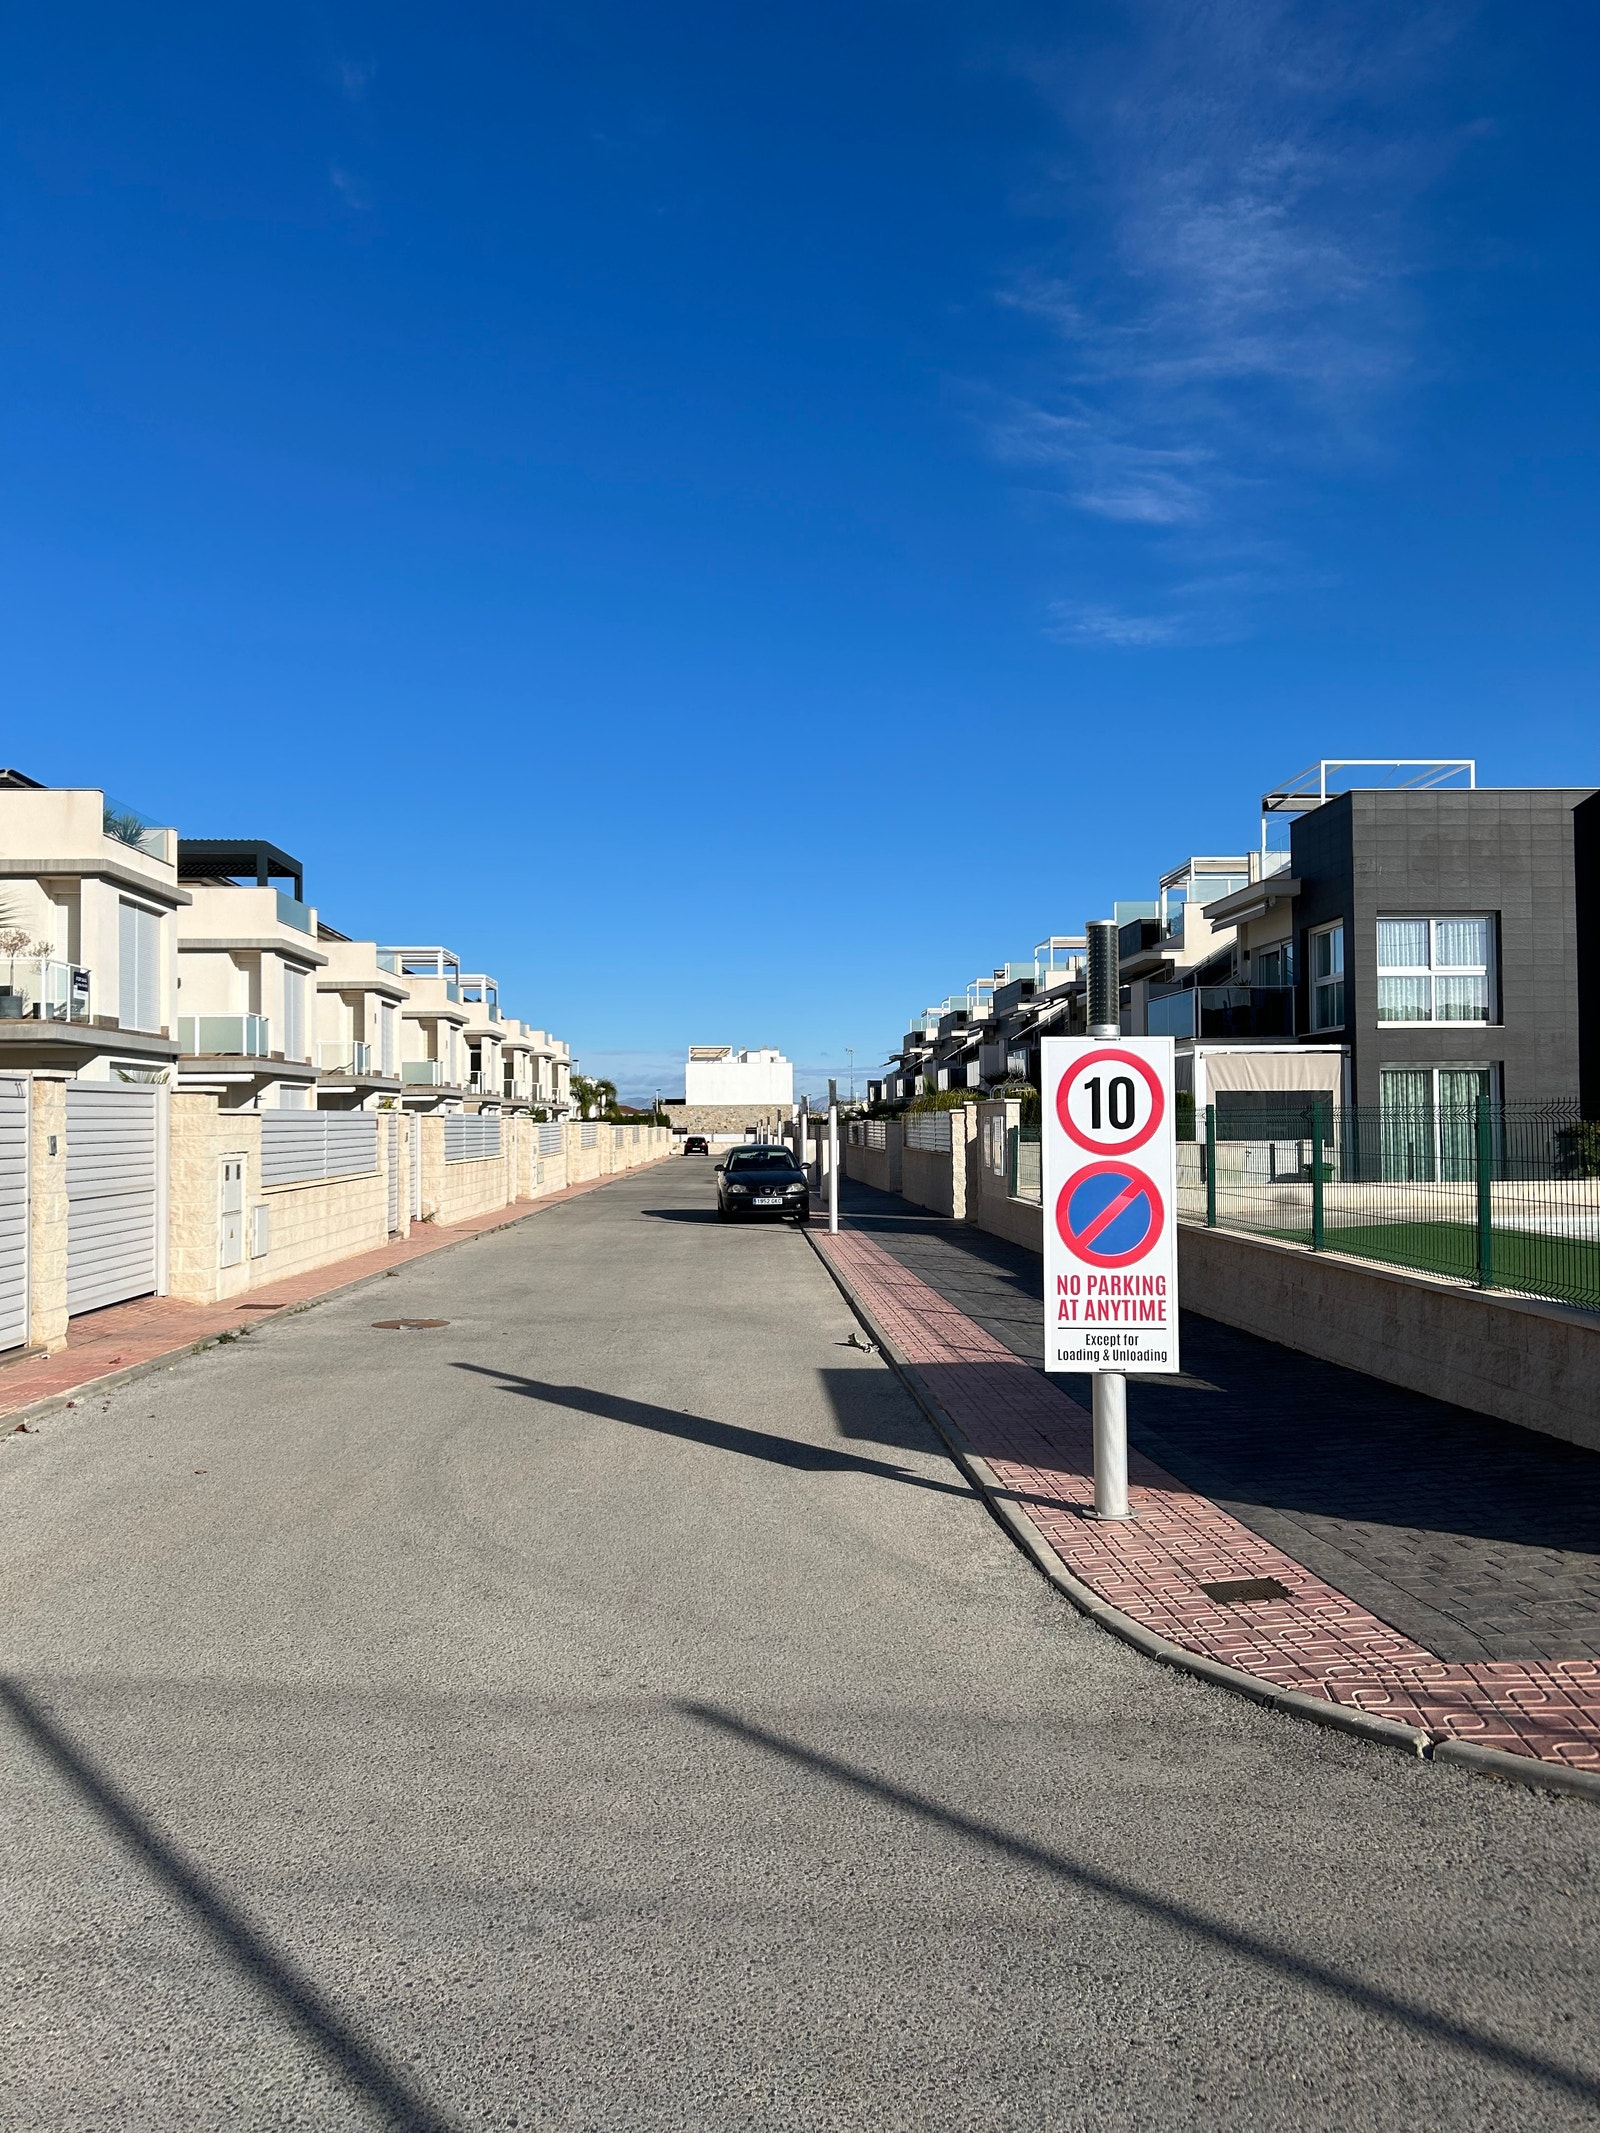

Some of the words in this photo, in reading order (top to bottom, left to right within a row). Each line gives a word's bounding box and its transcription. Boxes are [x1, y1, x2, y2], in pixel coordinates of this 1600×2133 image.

[1084, 1076, 1135, 1130] 10
[1057, 1275, 1081, 1296] NO
[1087, 1275, 1167, 1296] PARKING
[1058, 1299, 1079, 1321] AT
[1084, 1299, 1167, 1321] ANYTIME
[1085, 1333, 1121, 1347] Except
[1123, 1333, 1139, 1346] for
[1057, 1348, 1100, 1362] Loading
[1102, 1348, 1110, 1361] &
[1112, 1348, 1168, 1363] Unloading
